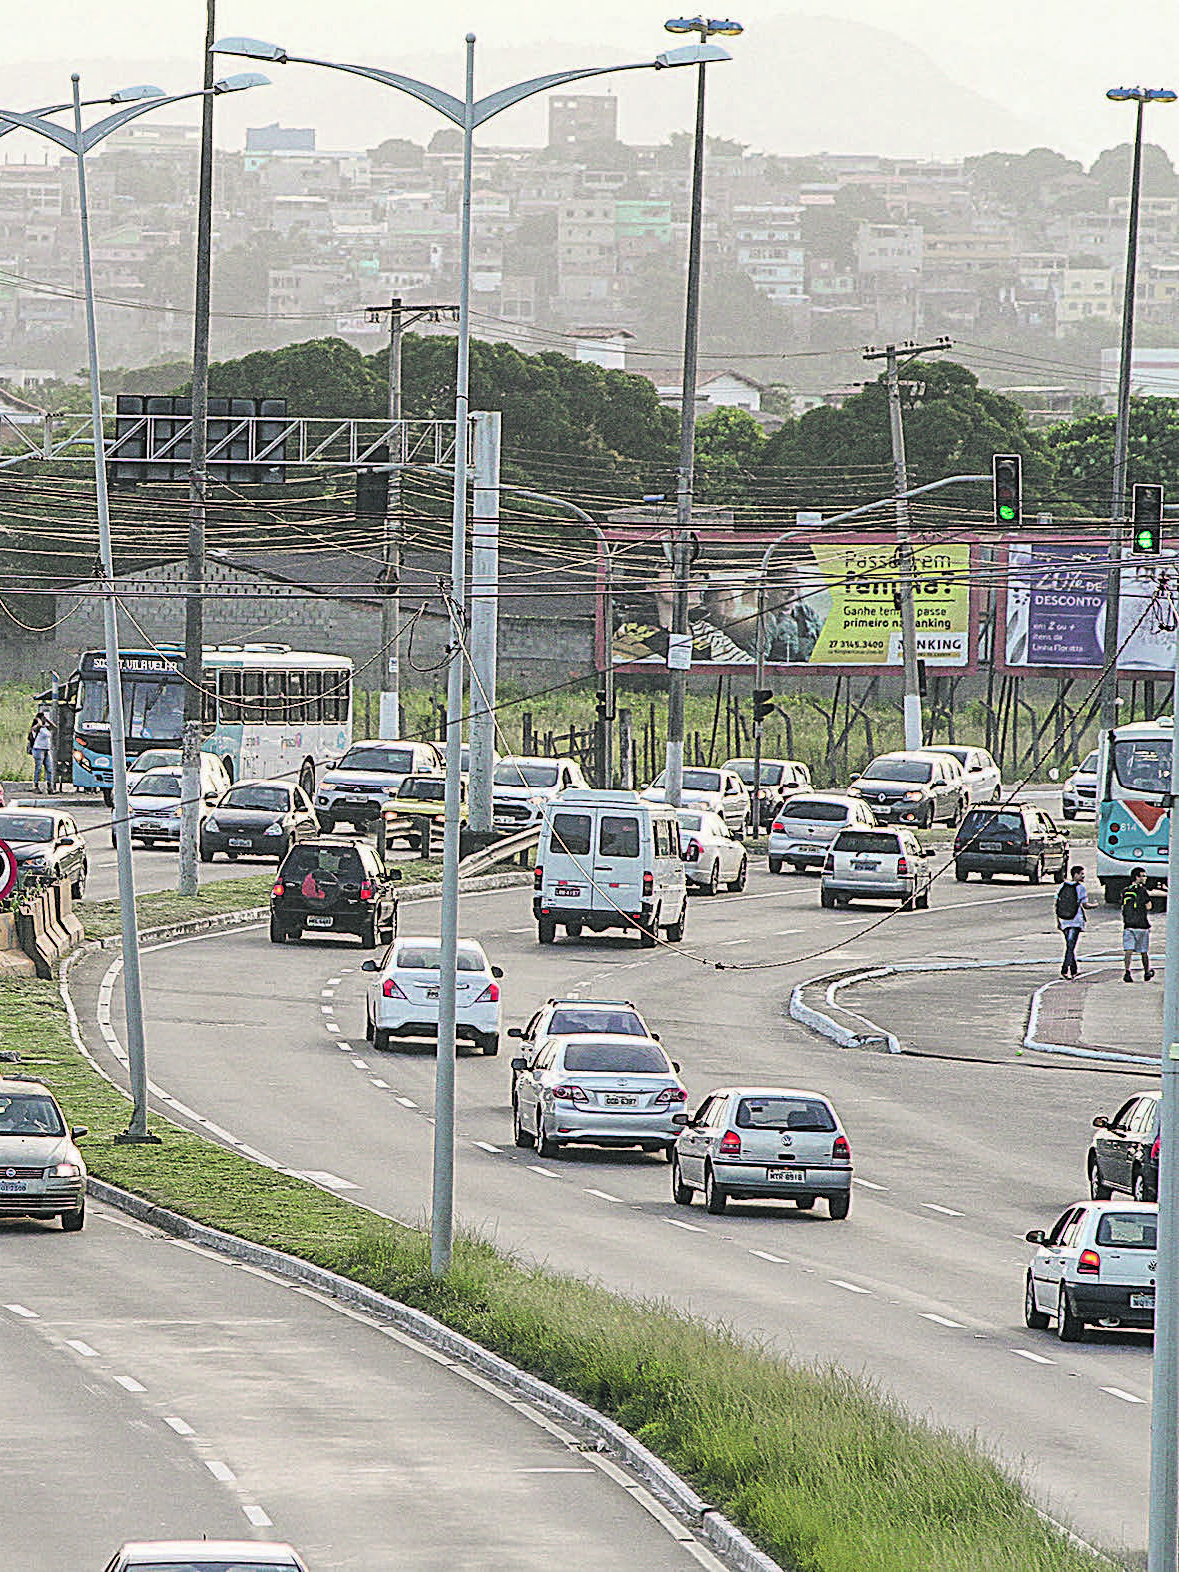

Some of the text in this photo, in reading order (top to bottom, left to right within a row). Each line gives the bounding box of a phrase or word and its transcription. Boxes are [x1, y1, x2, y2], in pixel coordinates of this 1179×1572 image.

[1086, 581, 1102, 593] DE
[1034, 595, 1102, 607] DESCONTO
[843, 606, 876, 617] Ganhe
[917, 608, 947, 617] passe
[843, 618, 889, 629] primeiro
[914, 618, 951, 630] anking
